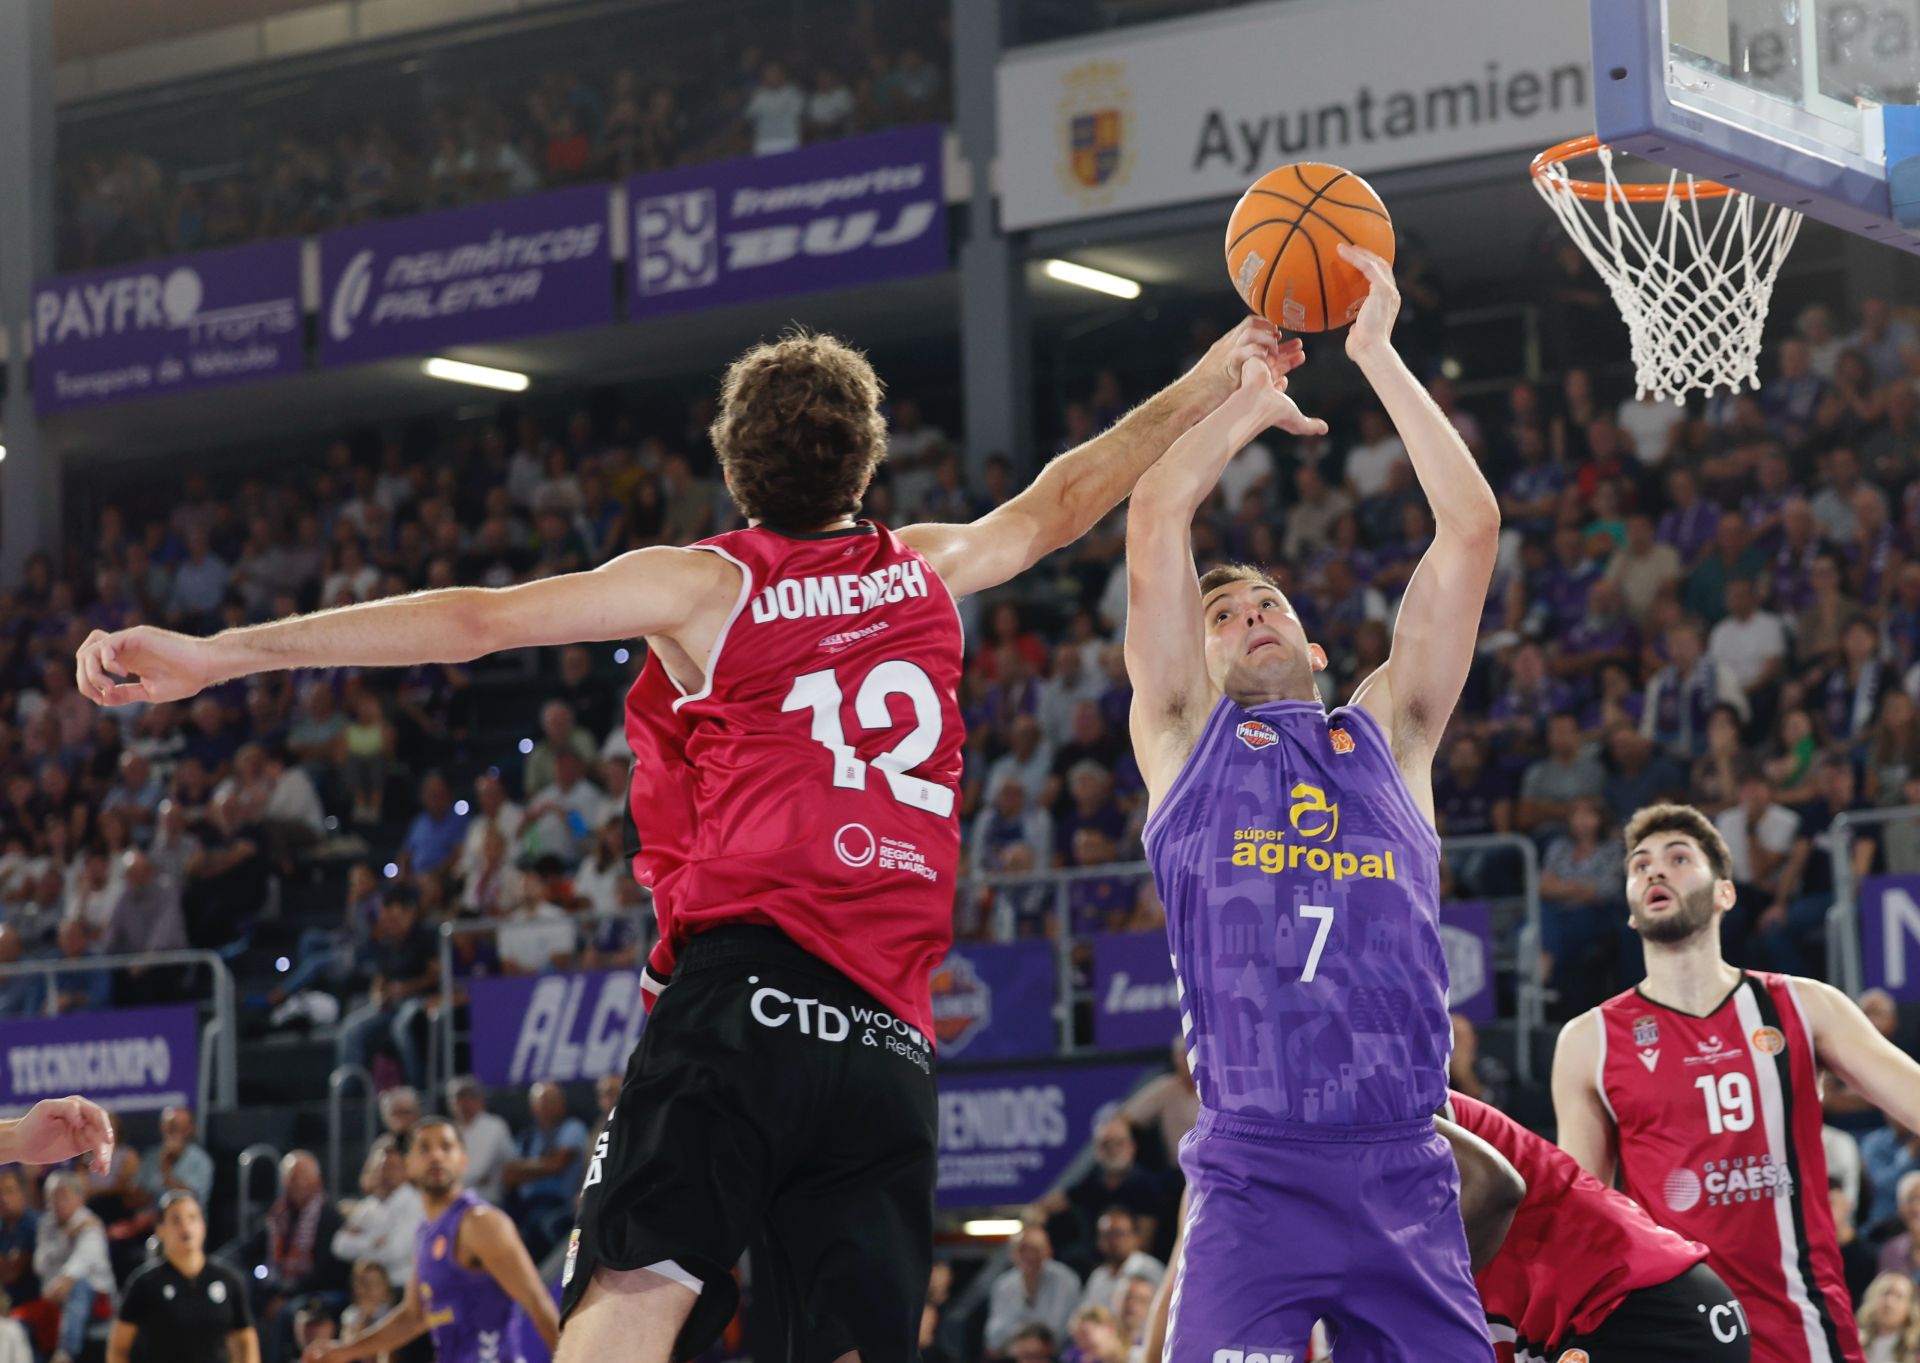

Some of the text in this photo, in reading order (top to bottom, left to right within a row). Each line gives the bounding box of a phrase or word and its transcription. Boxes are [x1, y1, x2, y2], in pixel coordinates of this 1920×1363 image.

[1193, 60, 1590, 176] Ayuntamien
[722, 201, 937, 271] BUJ
[370, 267, 543, 327] PALENCIA
[751, 559, 928, 624] DOMENECH
[780, 659, 956, 819] 12
[1239, 727, 1277, 742] PALENCIA
[1233, 826, 1285, 842] súper
[878, 857, 938, 882] DE MURCIA
[879, 845, 926, 865] REGIÓN
[1231, 841, 1396, 881] agropal
[1299, 905, 1334, 983] 7
[750, 986, 850, 1043] CTD
[861, 1028, 878, 1047] &
[1694, 1072, 1755, 1135] 19
[1703, 1153, 1773, 1173] GRUPO
[1704, 1162, 1794, 1194] CAESA
[1707, 1184, 1795, 1207] SEGUROS
